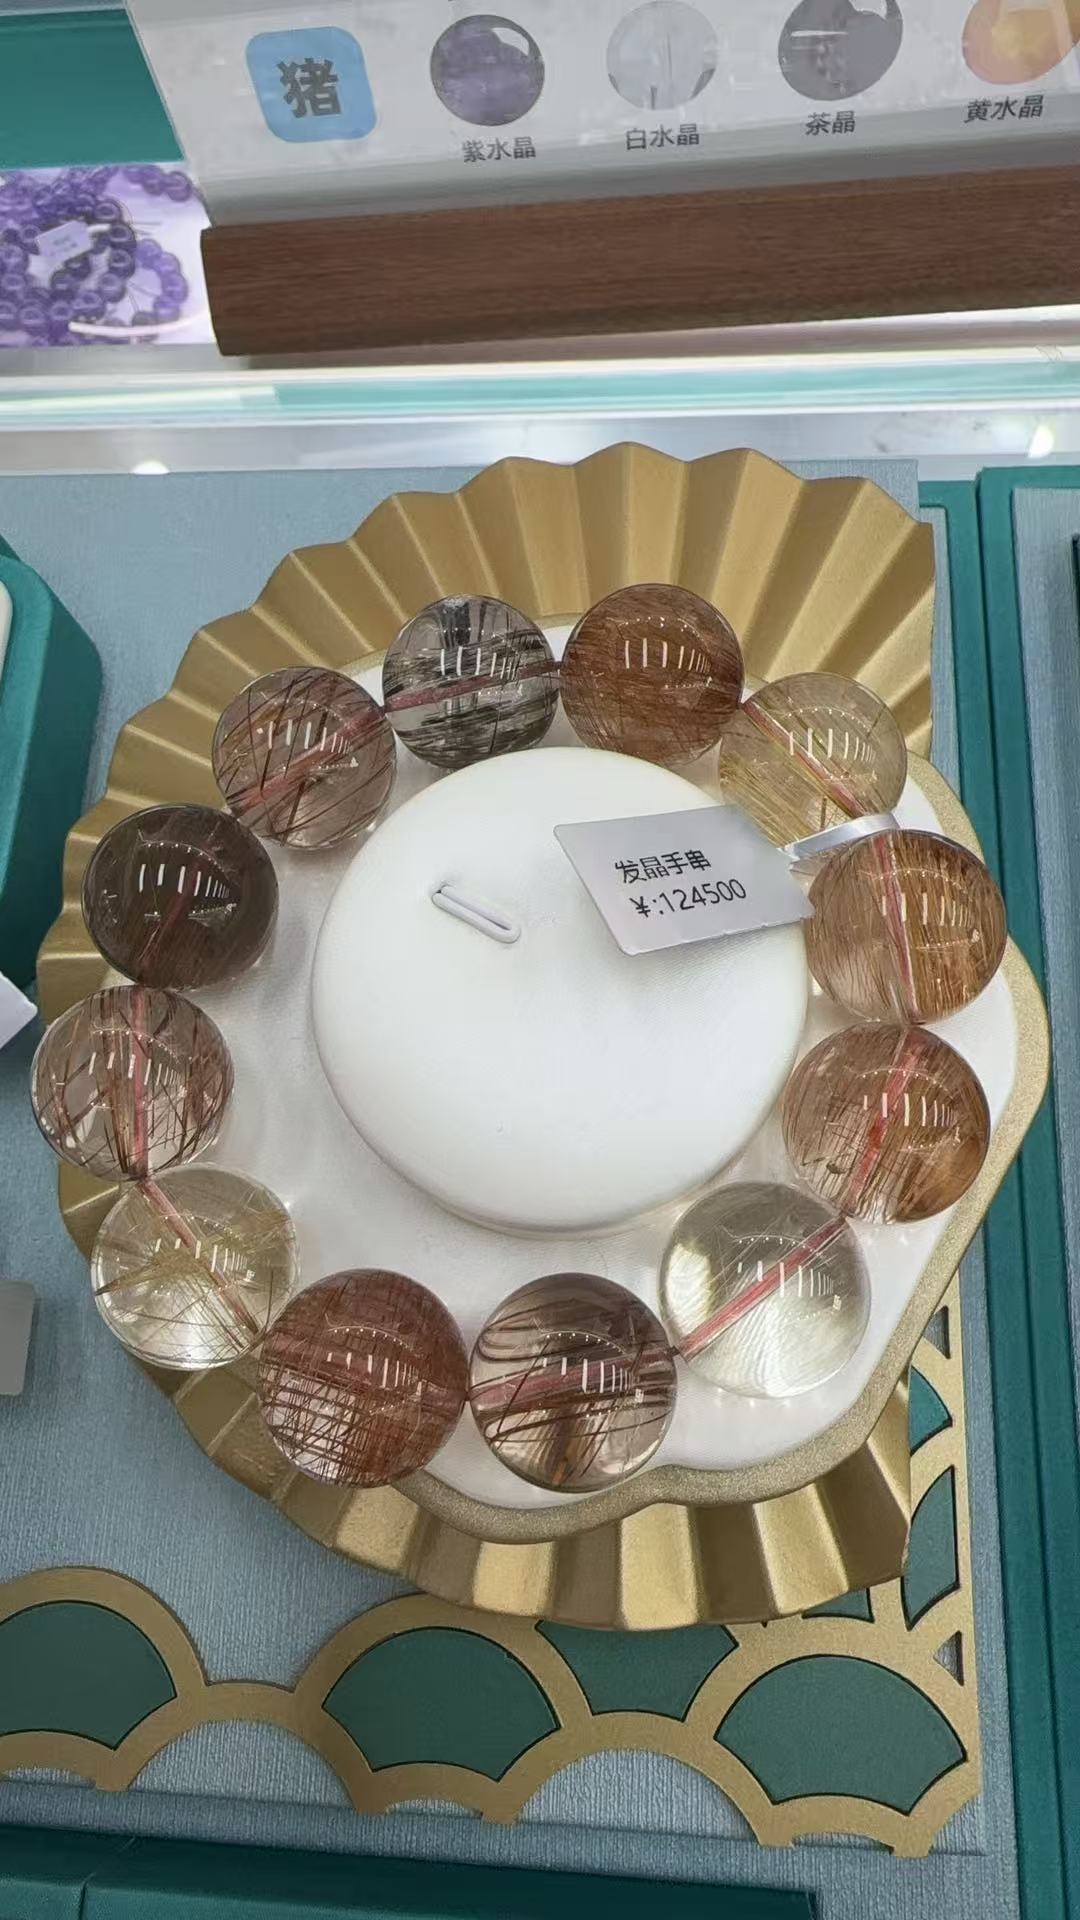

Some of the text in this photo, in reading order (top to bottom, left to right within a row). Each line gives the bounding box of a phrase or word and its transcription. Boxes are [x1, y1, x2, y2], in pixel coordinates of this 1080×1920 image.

[277, 57, 342, 118] 猪
[805, 110, 856, 137] 茶晶
[963, 94, 1044, 124] 黄水晶
[461, 136, 536, 163] 紫水晶
[625, 123, 700, 151] 白水晶
[615, 849, 711, 884] 发晶手串
